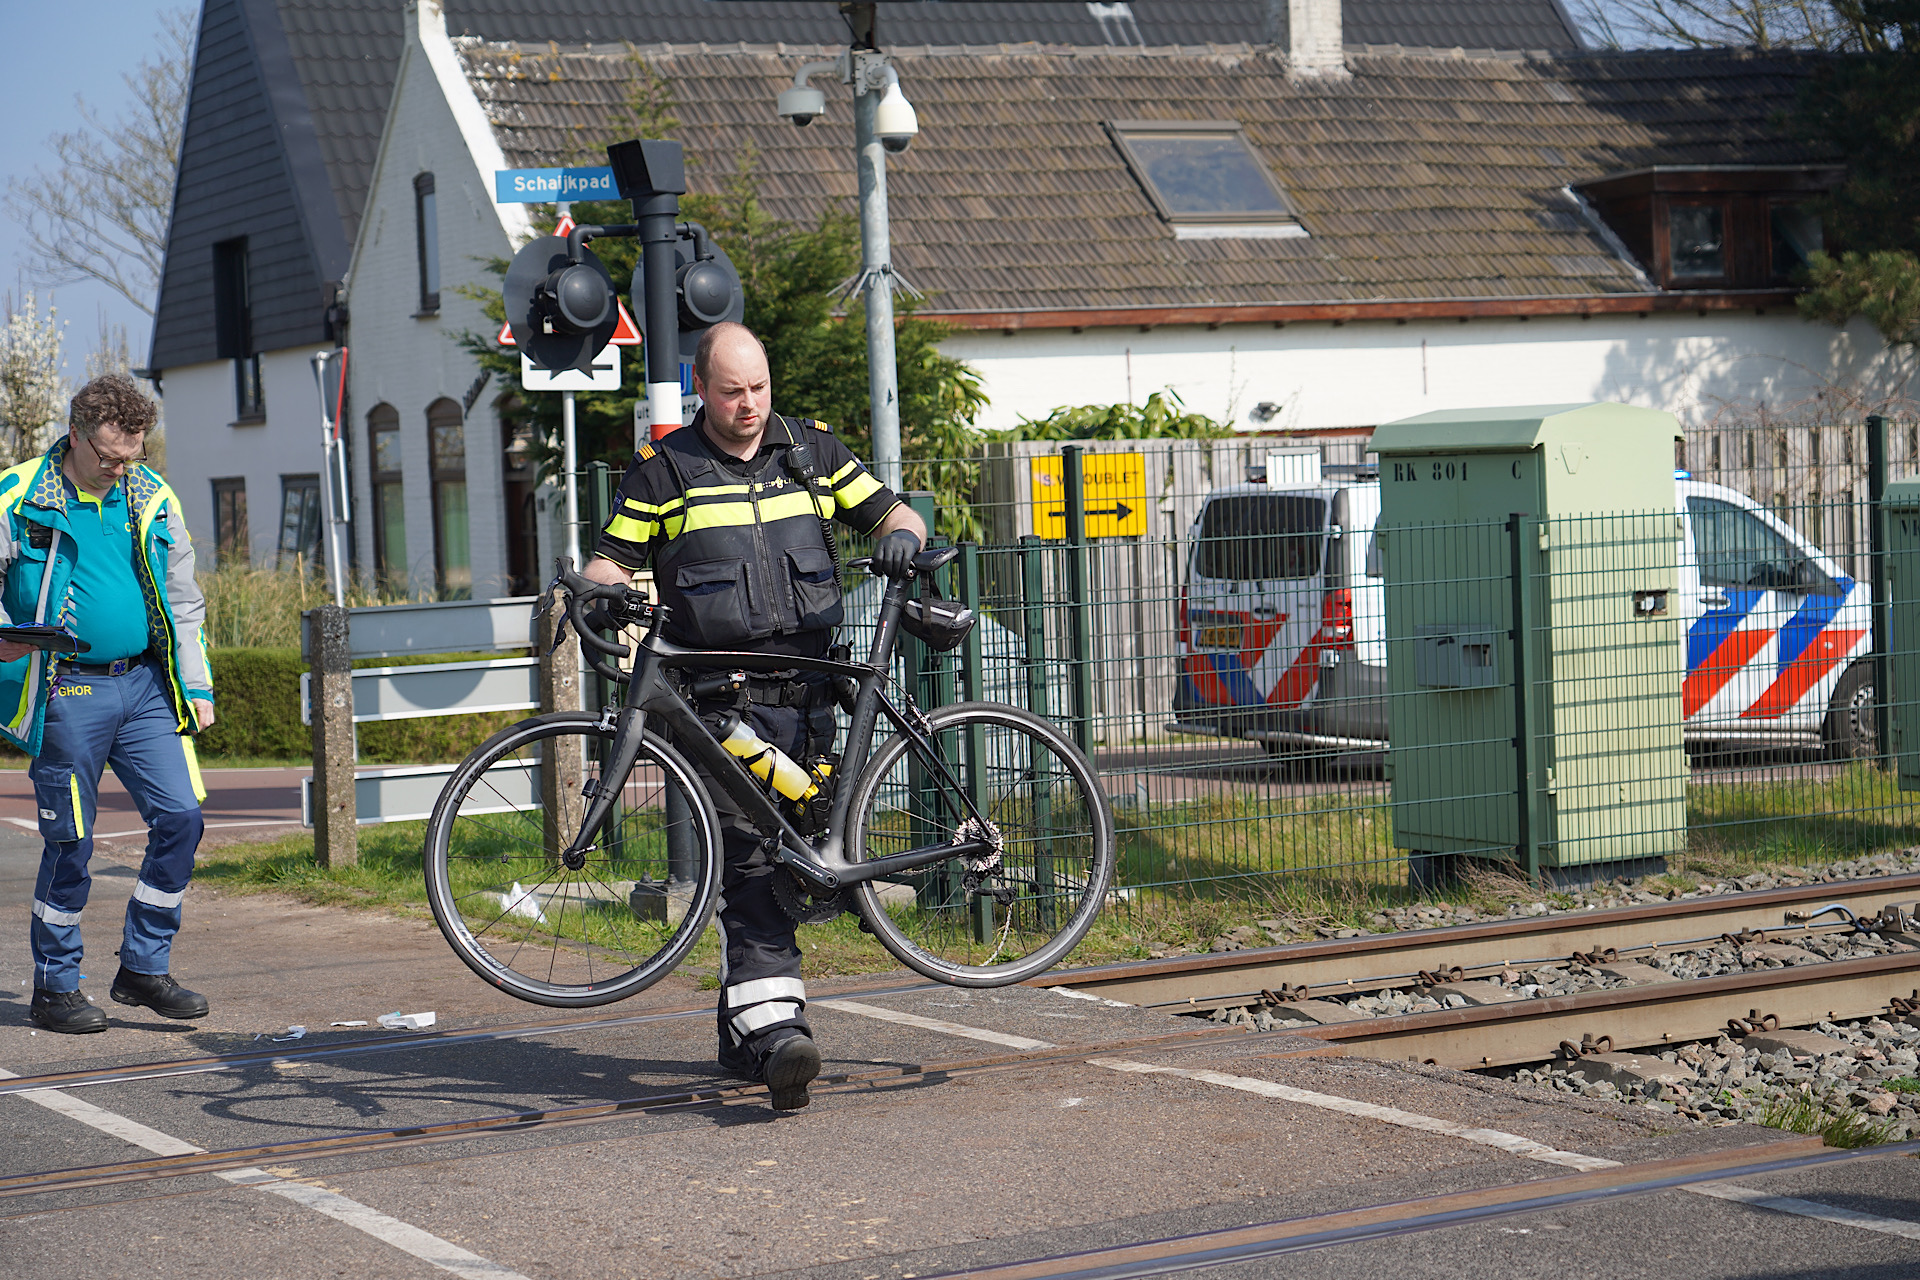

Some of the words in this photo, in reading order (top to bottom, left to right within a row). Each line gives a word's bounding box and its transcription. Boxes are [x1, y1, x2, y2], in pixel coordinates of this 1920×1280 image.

[514, 174, 610, 194] Schaijkpad
[1081, 471, 1140, 485] OUBLET
[1432, 461, 1467, 481] 801
[1511, 460, 1522, 480] C
[58, 685, 92, 697] GHOR
